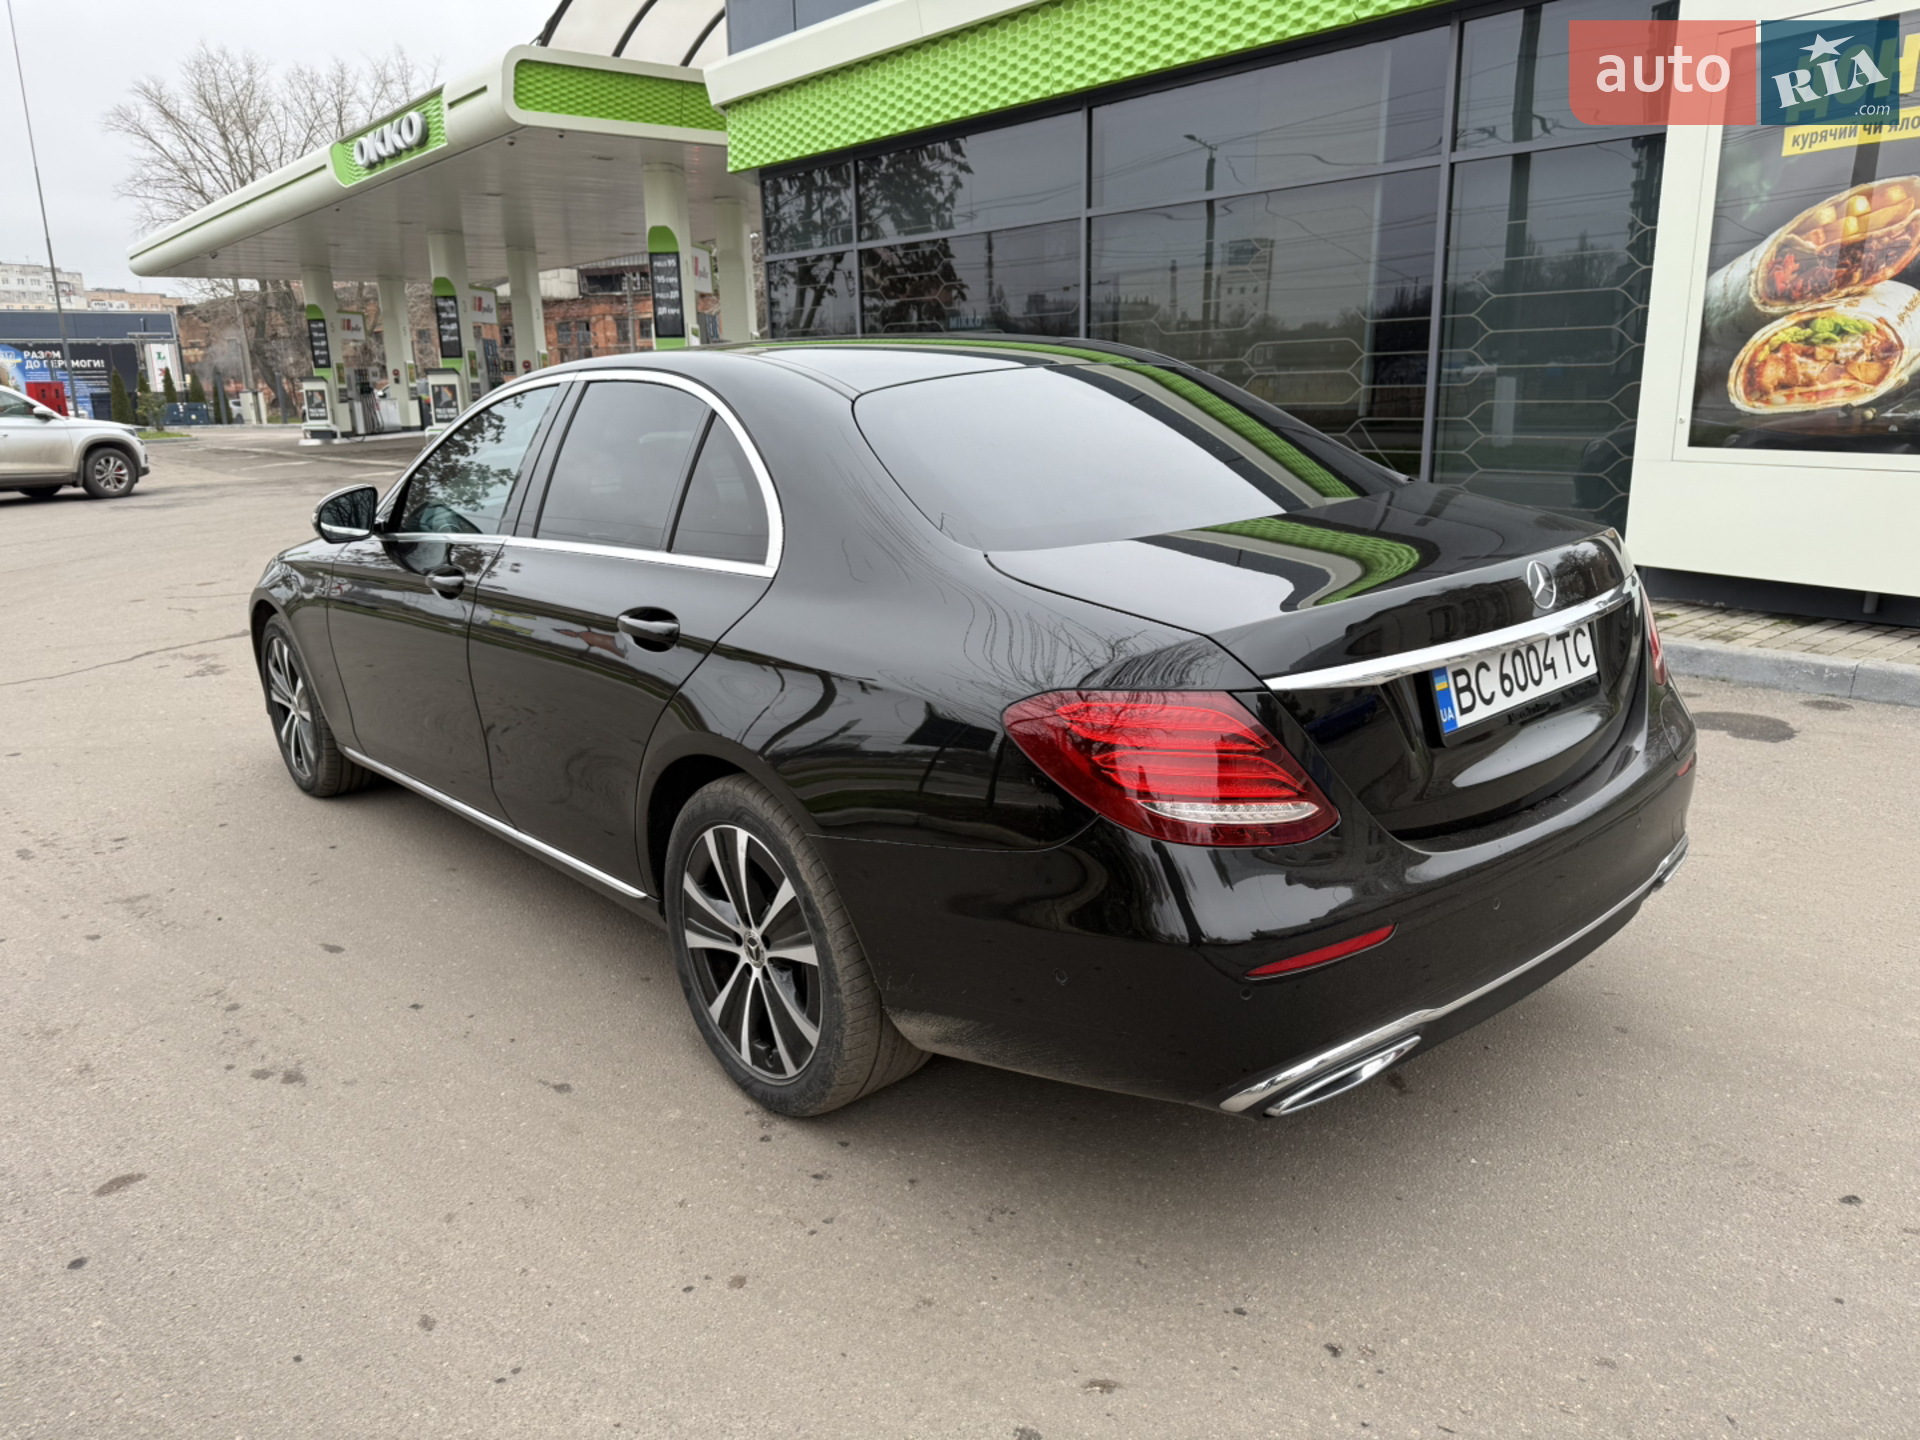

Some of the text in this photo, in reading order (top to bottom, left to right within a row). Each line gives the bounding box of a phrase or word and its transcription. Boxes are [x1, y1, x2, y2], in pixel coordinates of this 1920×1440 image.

[354, 111, 428, 169] OKKO
[1791, 121, 1859, 151] курячий
[1862, 120, 1884, 136] чи
[25, 359, 41, 370] ДО
[1452, 660, 1496, 716] BC
[1500, 638, 1558, 698] 6004
[1556, 627, 1591, 673] TC
[1440, 706, 1456, 724] UA
